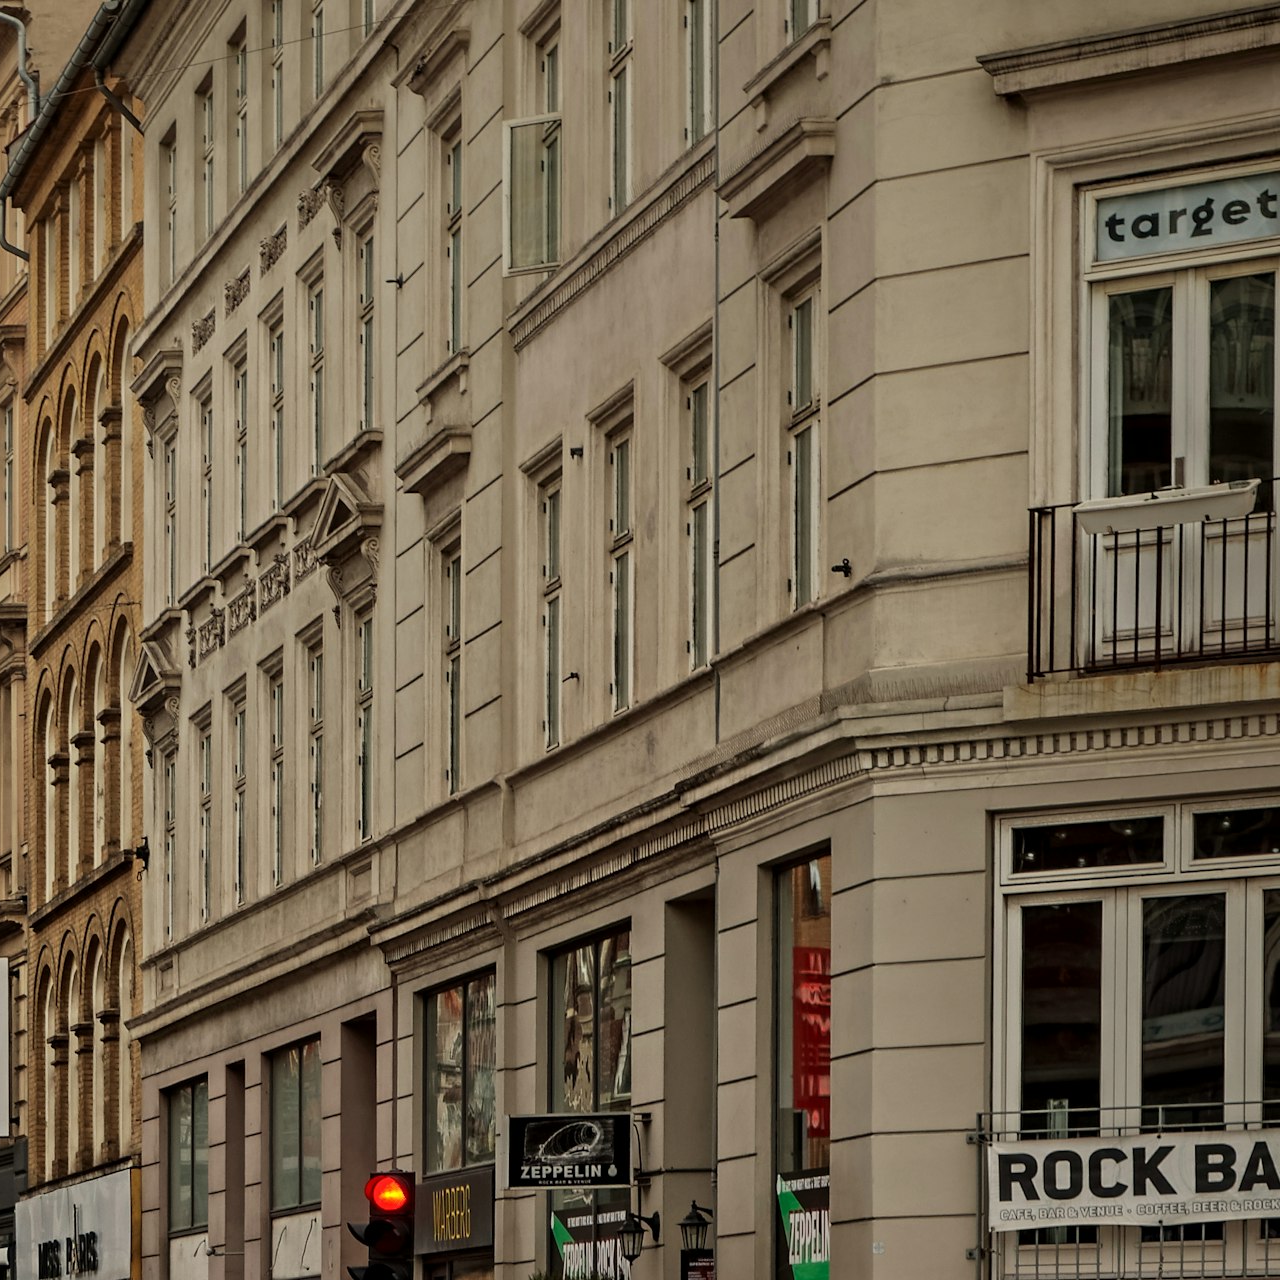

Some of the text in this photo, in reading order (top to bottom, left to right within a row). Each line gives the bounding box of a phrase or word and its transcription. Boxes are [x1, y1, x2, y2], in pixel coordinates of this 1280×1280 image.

[1104, 188, 1278, 242] target
[521, 1164, 602, 1179] ZEPPELIN
[998, 1141, 1280, 1202] ROCK BA
[432, 1183, 472, 1241] WARBERG
[1000, 1208, 1037, 1222] CAFE,
[1039, 1207, 1065, 1219] BAR
[1067, 1207, 1078, 1218] &
[1080, 1205, 1123, 1217] VENUE
[1136, 1202, 1190, 1217] COFFEE,
[1192, 1200, 1228, 1213] BEER
[1230, 1200, 1241, 1211] &
